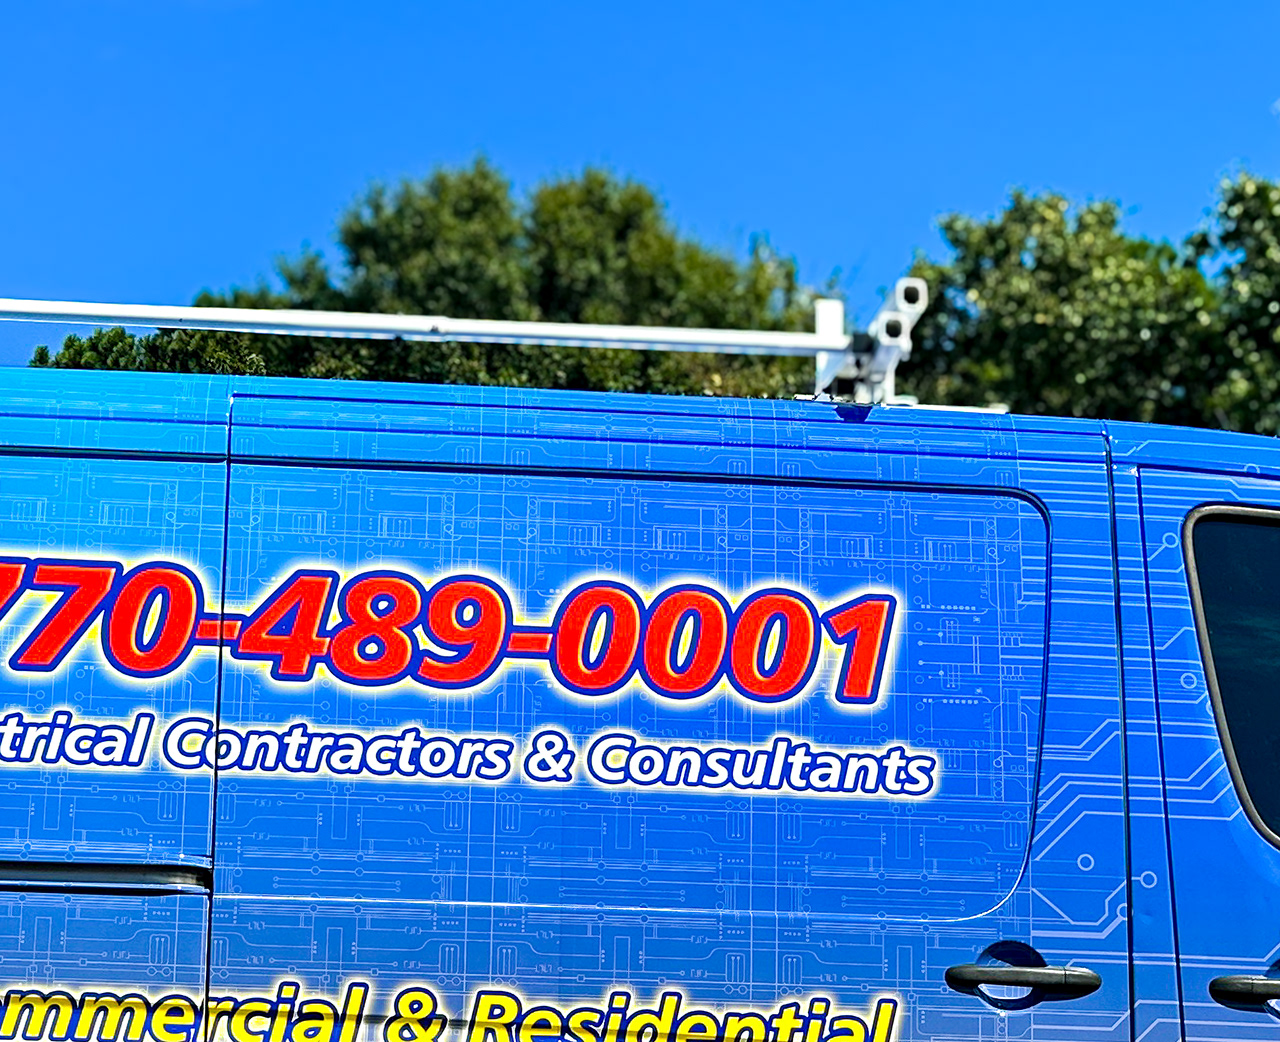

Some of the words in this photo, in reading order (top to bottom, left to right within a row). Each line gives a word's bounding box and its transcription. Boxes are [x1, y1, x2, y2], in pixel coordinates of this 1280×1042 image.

[163, 717, 511, 782] Contractors
[524, 732, 575, 780] &
[586, 735, 934, 795] Consultants
